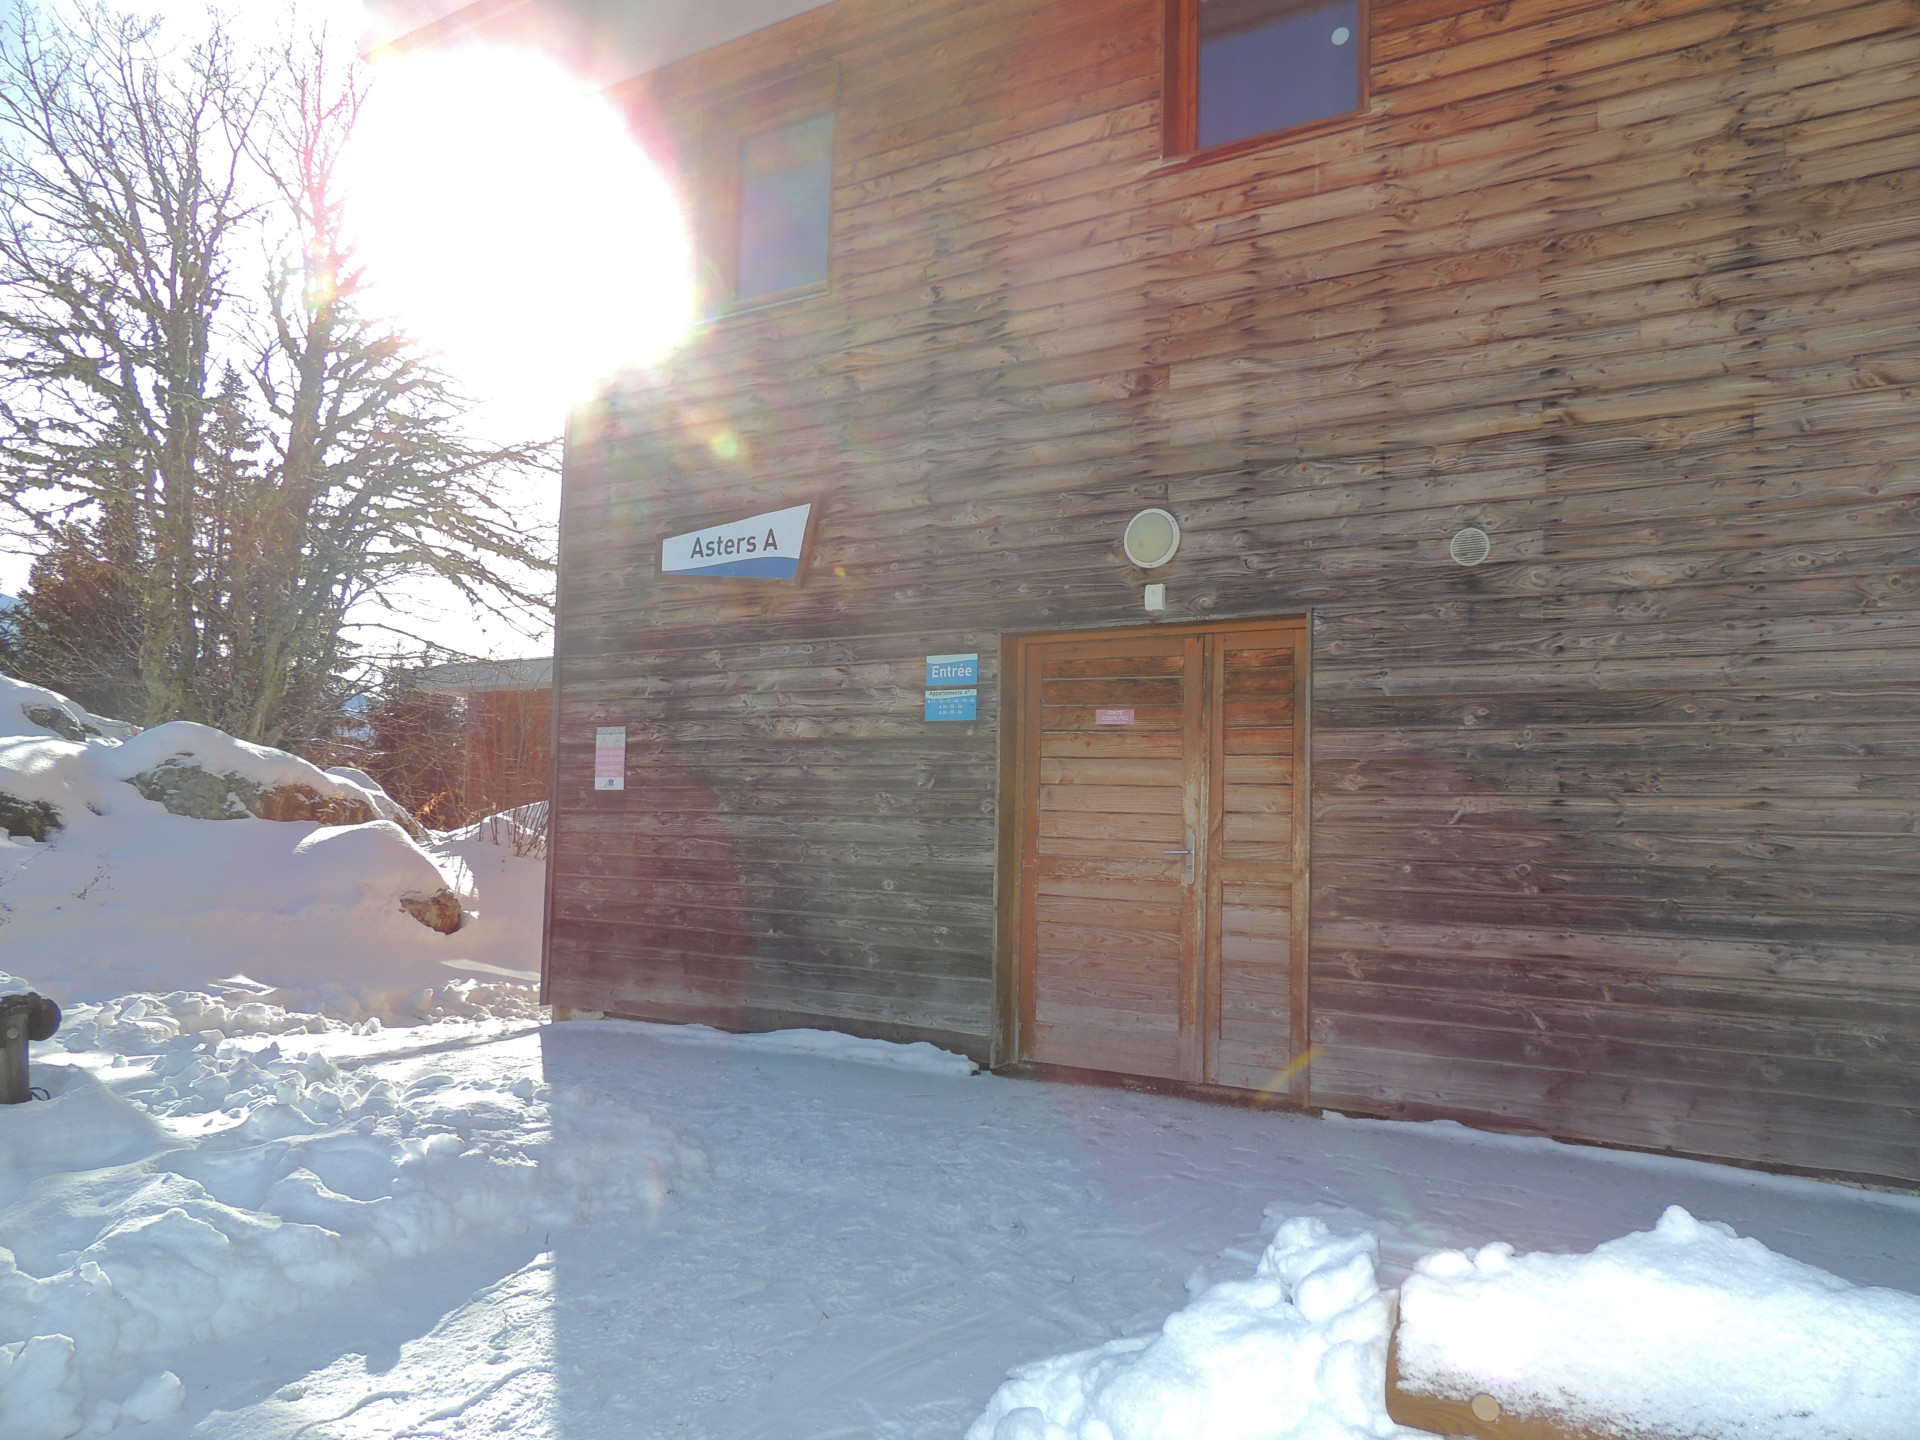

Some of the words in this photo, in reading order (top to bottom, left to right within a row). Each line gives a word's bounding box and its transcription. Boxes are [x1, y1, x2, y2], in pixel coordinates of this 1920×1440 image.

[690, 535, 757, 558] Asters
[762, 528, 778, 551] A
[932, 664, 972, 678] Entrée
